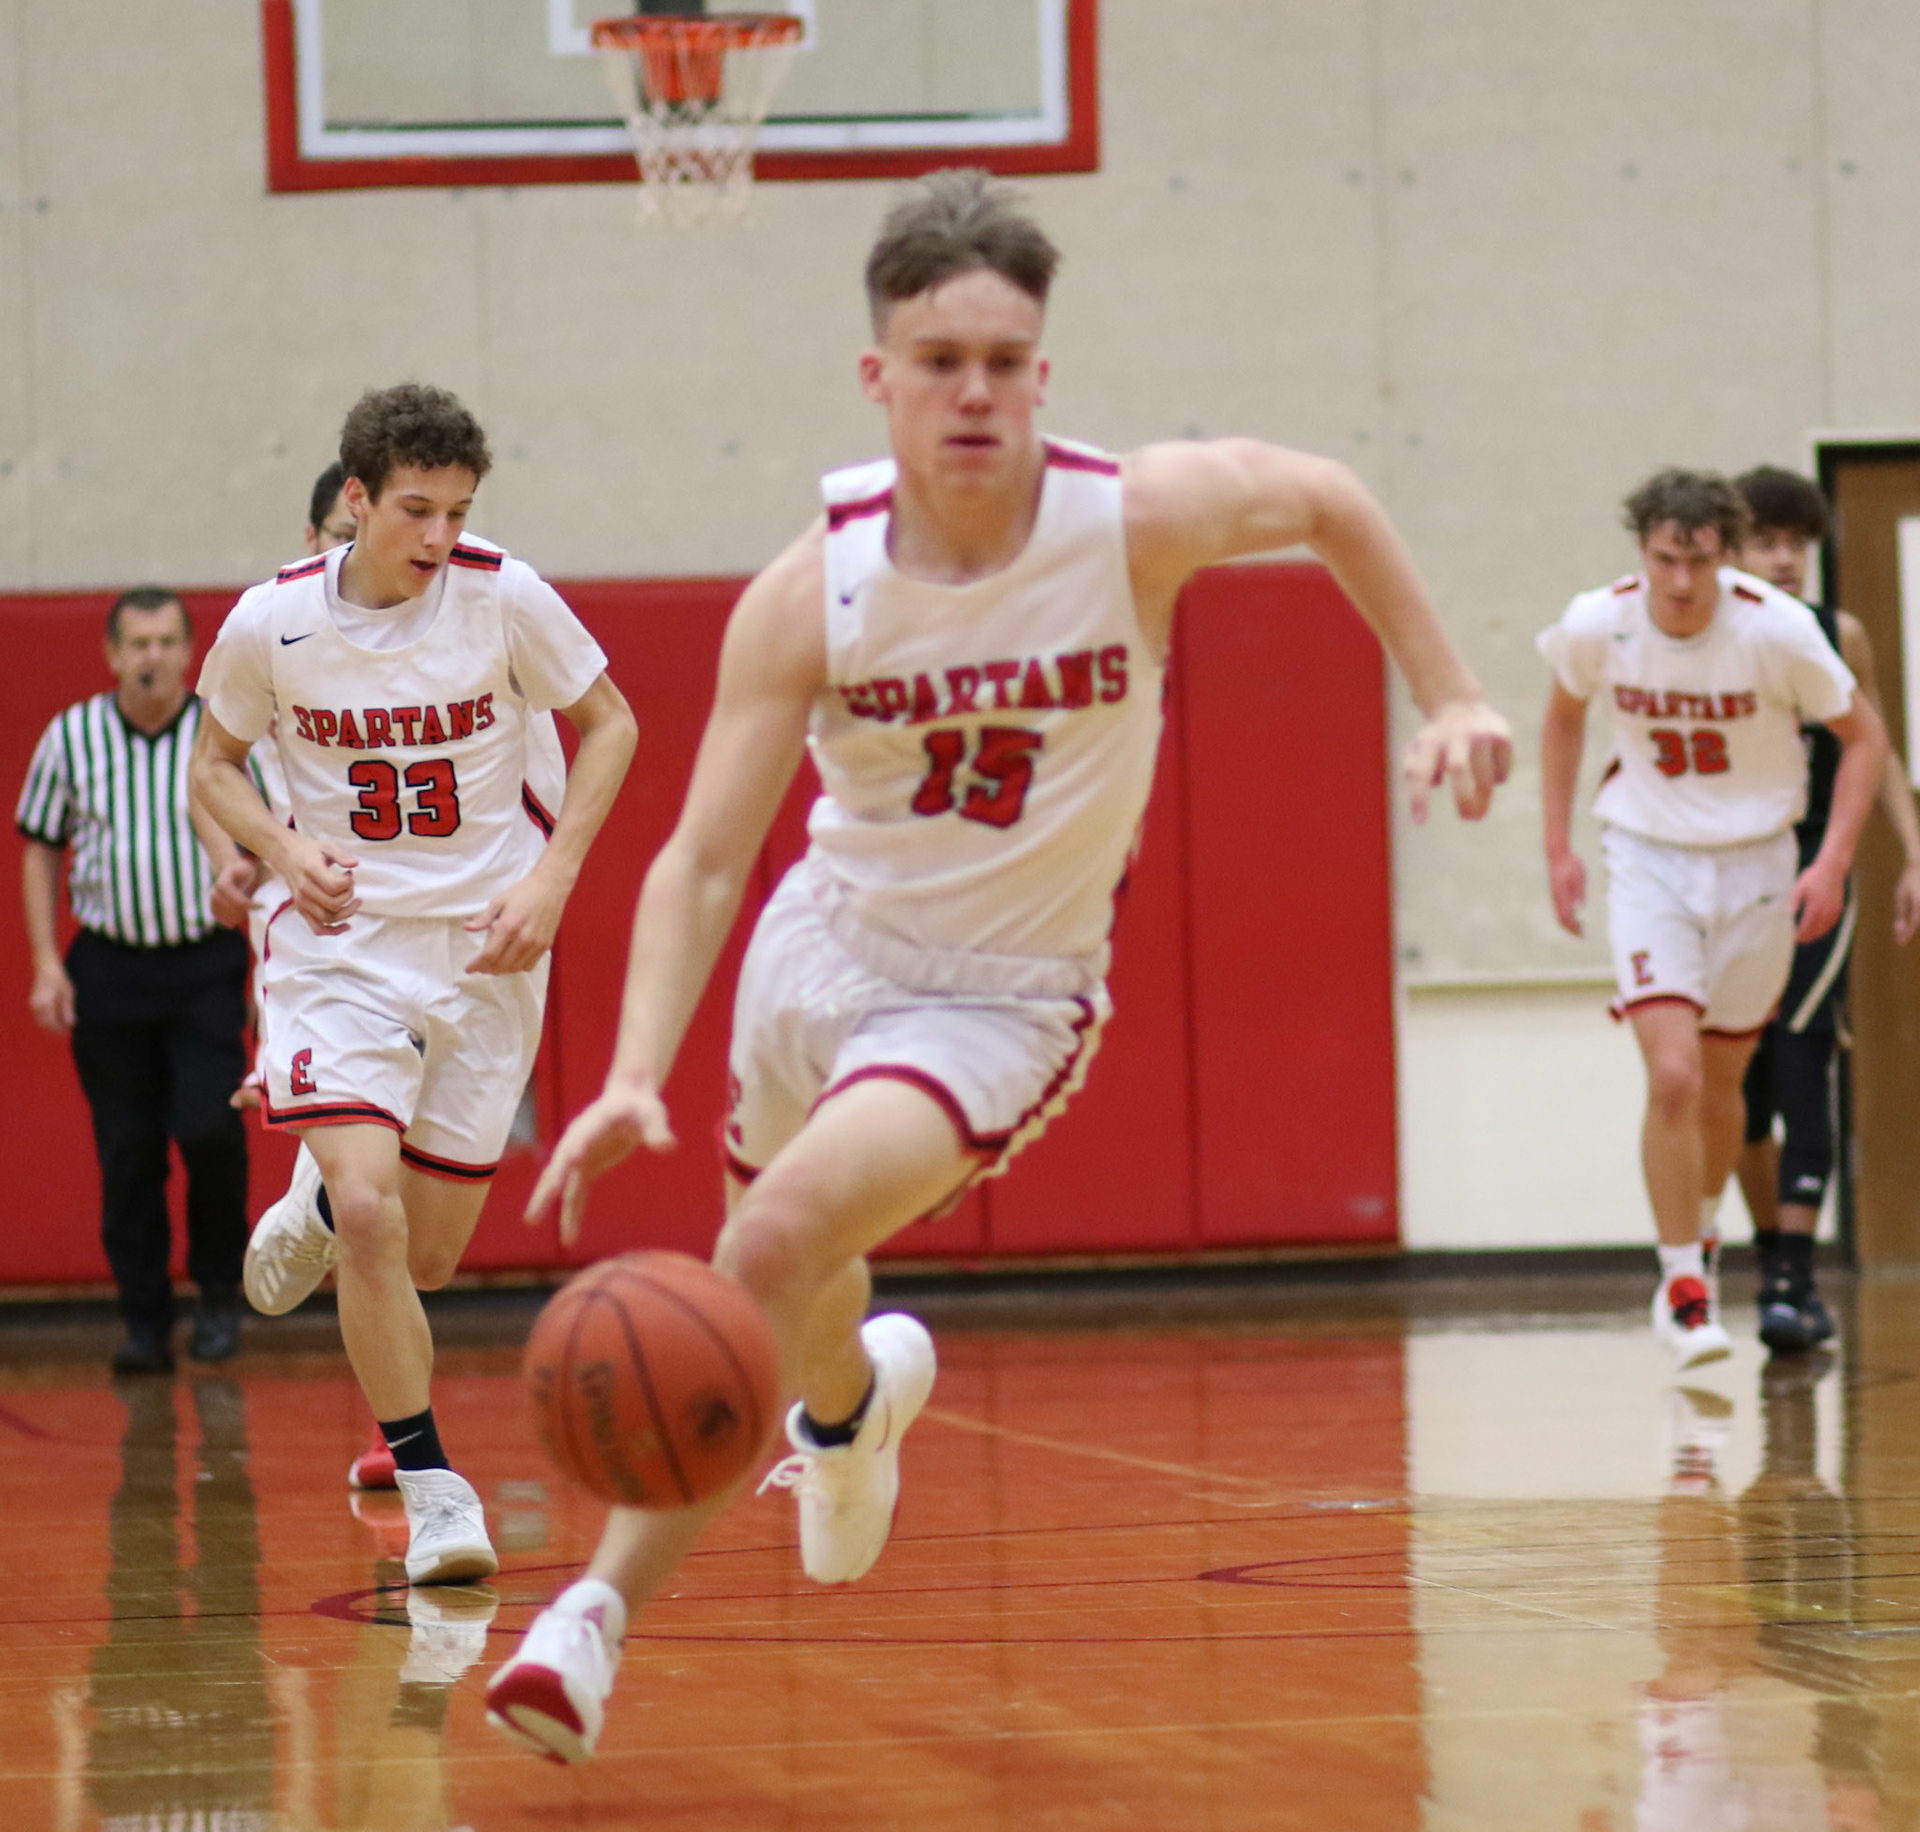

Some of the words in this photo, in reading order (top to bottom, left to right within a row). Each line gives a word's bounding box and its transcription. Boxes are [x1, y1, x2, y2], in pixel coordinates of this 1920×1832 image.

[292, 692, 495, 749] SPARTANS
[911, 725, 1044, 829] 15
[1649, 727, 1730, 778] 32
[348, 758, 461, 841] 33
[290, 1047, 317, 1096] E
